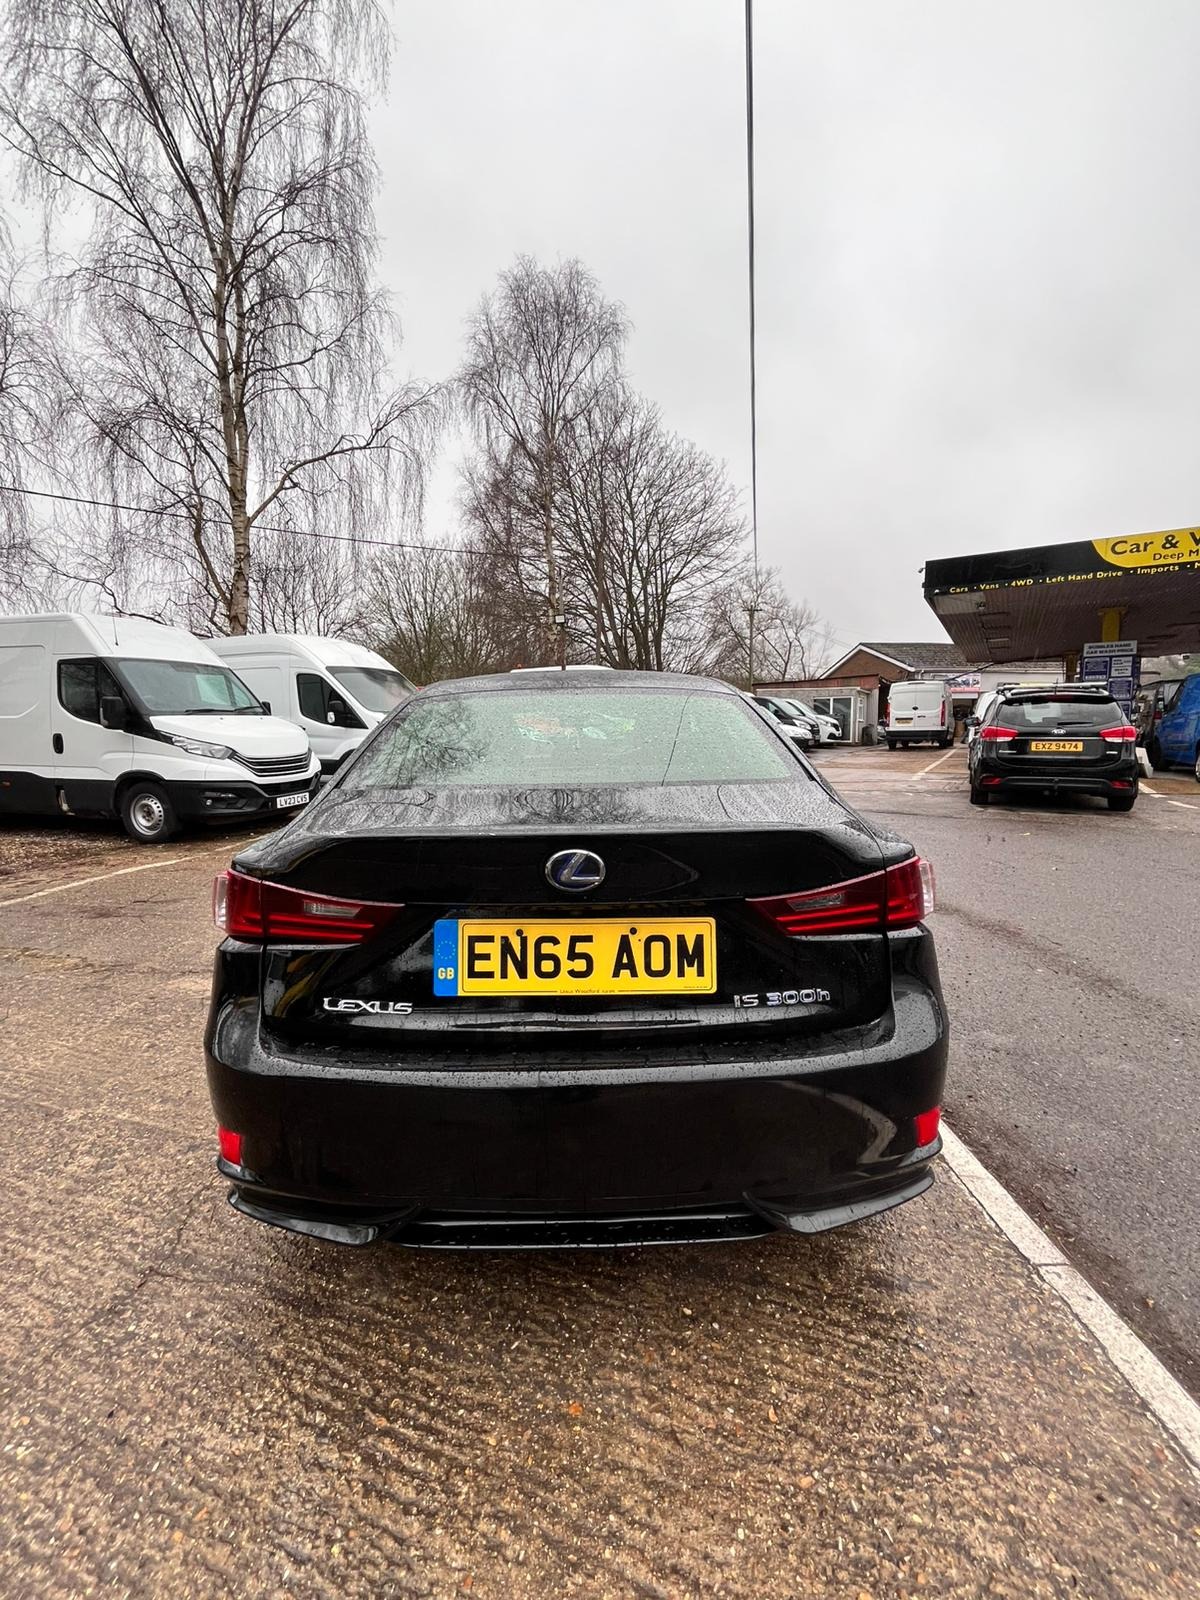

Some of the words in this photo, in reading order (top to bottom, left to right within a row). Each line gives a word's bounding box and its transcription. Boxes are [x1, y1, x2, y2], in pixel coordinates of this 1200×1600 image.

[1111, 540, 1154, 555] Car
[1161, 534, 1180, 550] &
[1153, 552, 1184, 561] Deep
[1010, 578, 1034, 587] 4WD
[1046, 575, 1066, 584] Left
[1068, 572, 1093, 581] Hand
[1096, 570, 1123, 579] Drive
[1137, 565, 1180, 575] Imports
[1055, 742, 1079, 750] 9474
[467, 934, 594, 980] EN65
[611, 933, 705, 978] AOM
[437, 967, 455, 980] GB
[323, 997, 413, 1015] LEXUS
[733, 993, 760, 1008] IS
[766, 988, 831, 1006] 300h
